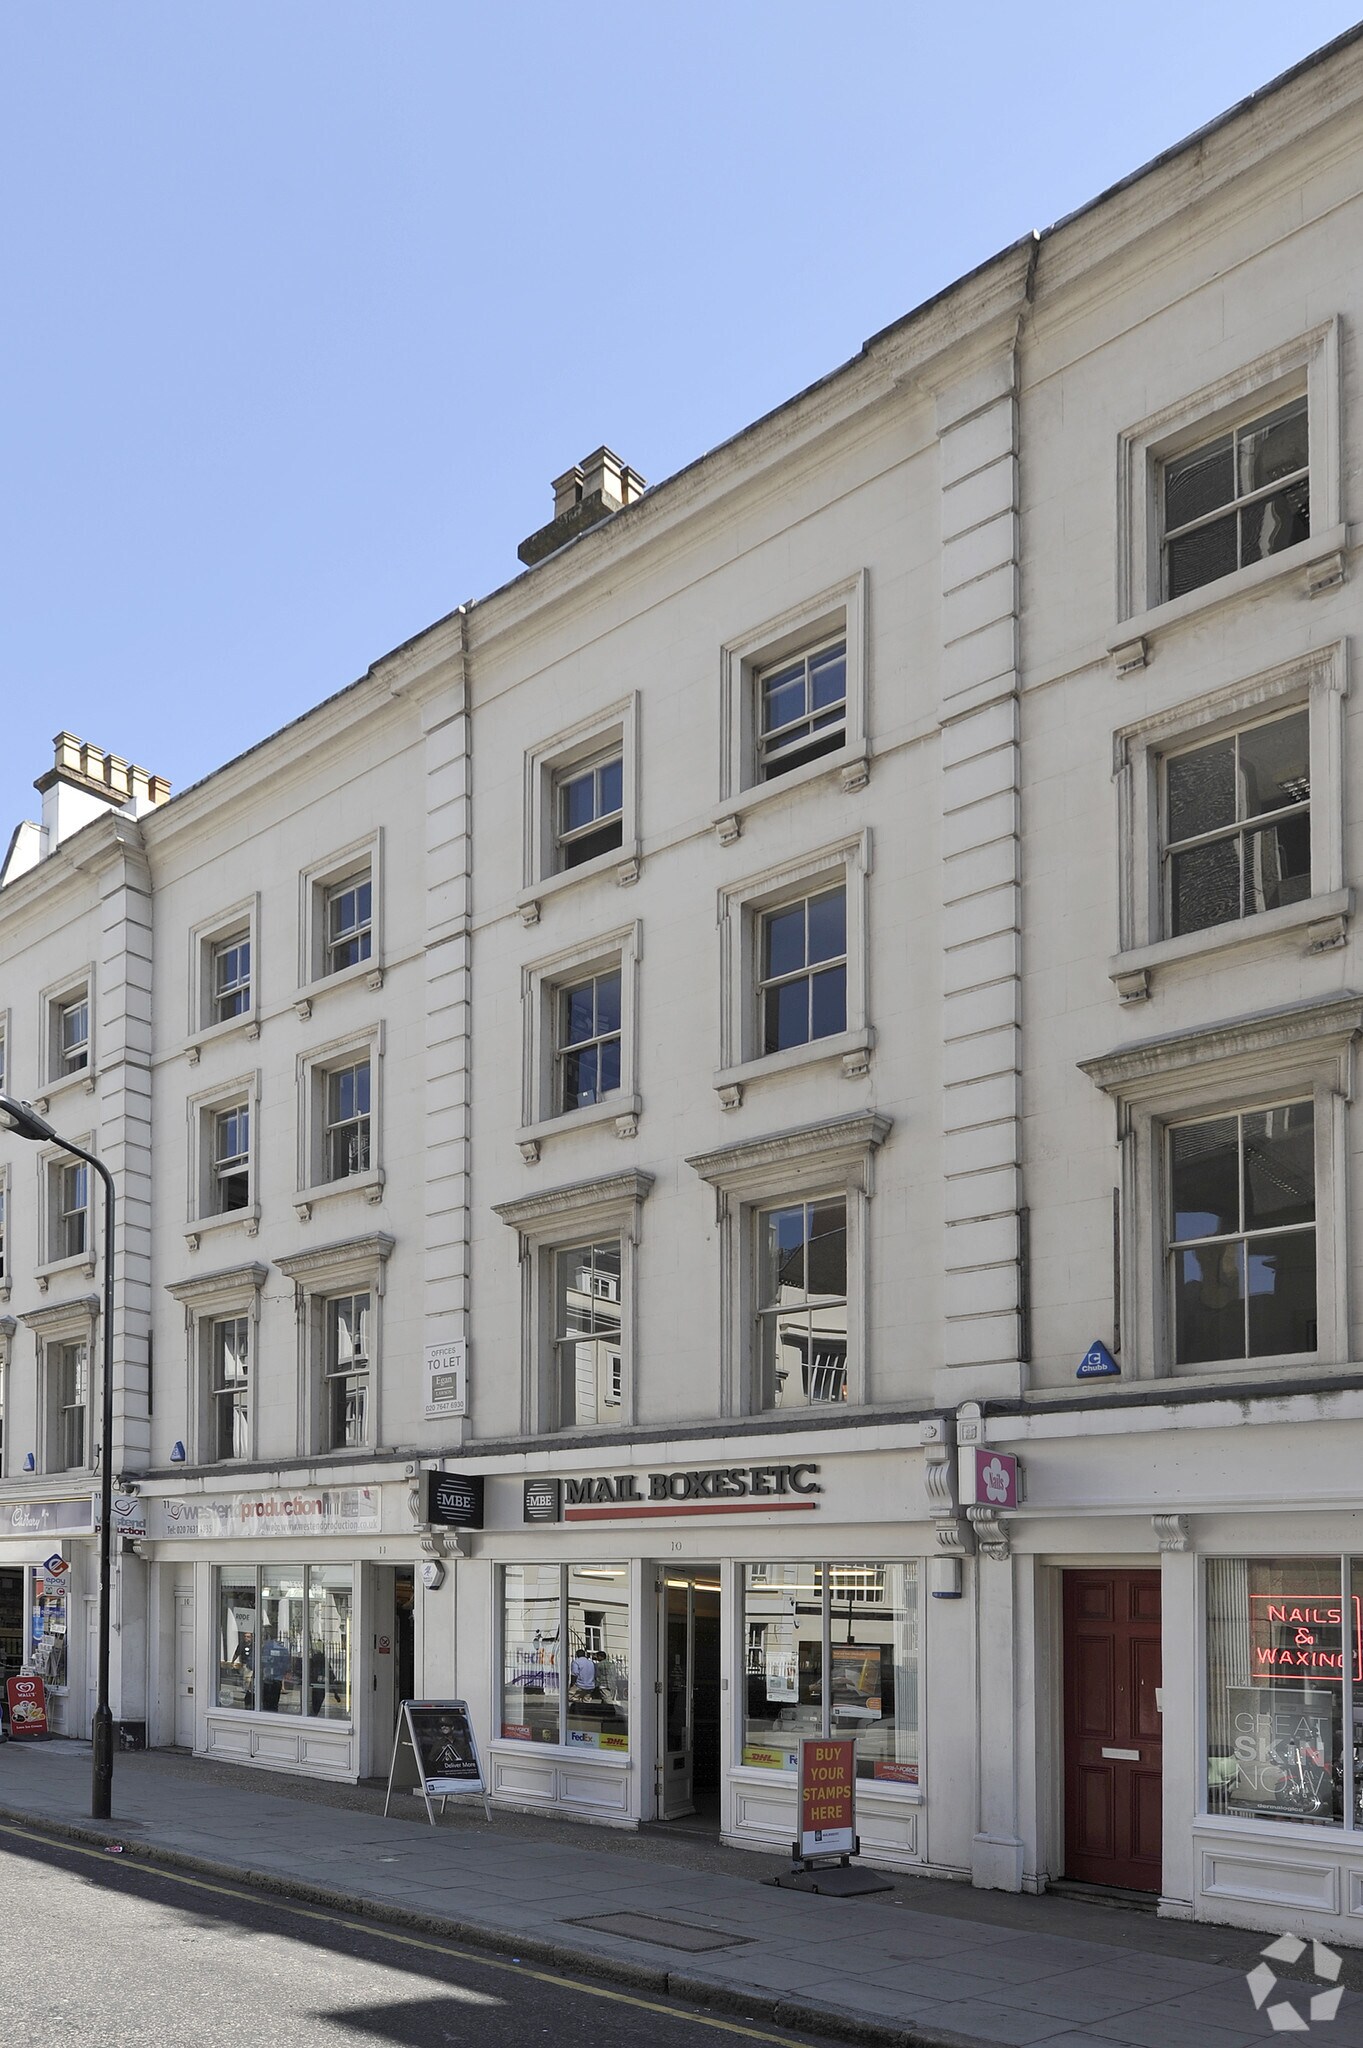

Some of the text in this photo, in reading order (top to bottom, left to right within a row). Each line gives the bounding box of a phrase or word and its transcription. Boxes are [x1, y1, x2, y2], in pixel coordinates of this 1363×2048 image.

[431, 1347, 456, 1357] OFFICES
[428, 1356, 461, 1370] TO LET
[1082, 1364, 1108, 1372] Chubb
[436, 1376, 452, 1386] Egan
[565, 1464, 820, 1504] MAIL BOXES ETC.
[989, 1472, 1004, 1490] Nails
[163, 1500, 170, 1508] 11
[442, 1494, 471, 1508] MBE
[530, 1495, 552, 1506] MBE
[12, 1507, 40, 1529] Cadbury
[671, 1541, 682, 1551] 10
[46, 1577, 66, 1586] epay
[1268, 1605, 1342, 1623] NAILS
[1295, 1627, 1313, 1645] &
[1234, 1712, 1329, 1737] GREAT
[571, 1732, 593, 1744] FedEx
[607, 1737, 626, 1747] DHL
[751, 1753, 774, 1763] DHL
[815, 1747, 842, 1761] BUY
[1234, 1735, 1325, 1768] SKIN
[444, 1760, 476, 1769] Deliver More
[810, 1766, 844, 1781] YOUR
[1235, 1763, 1325, 1796] NOW
[803, 1785, 851, 1801] STAMPS
[811, 1805, 842, 1820] HERE
